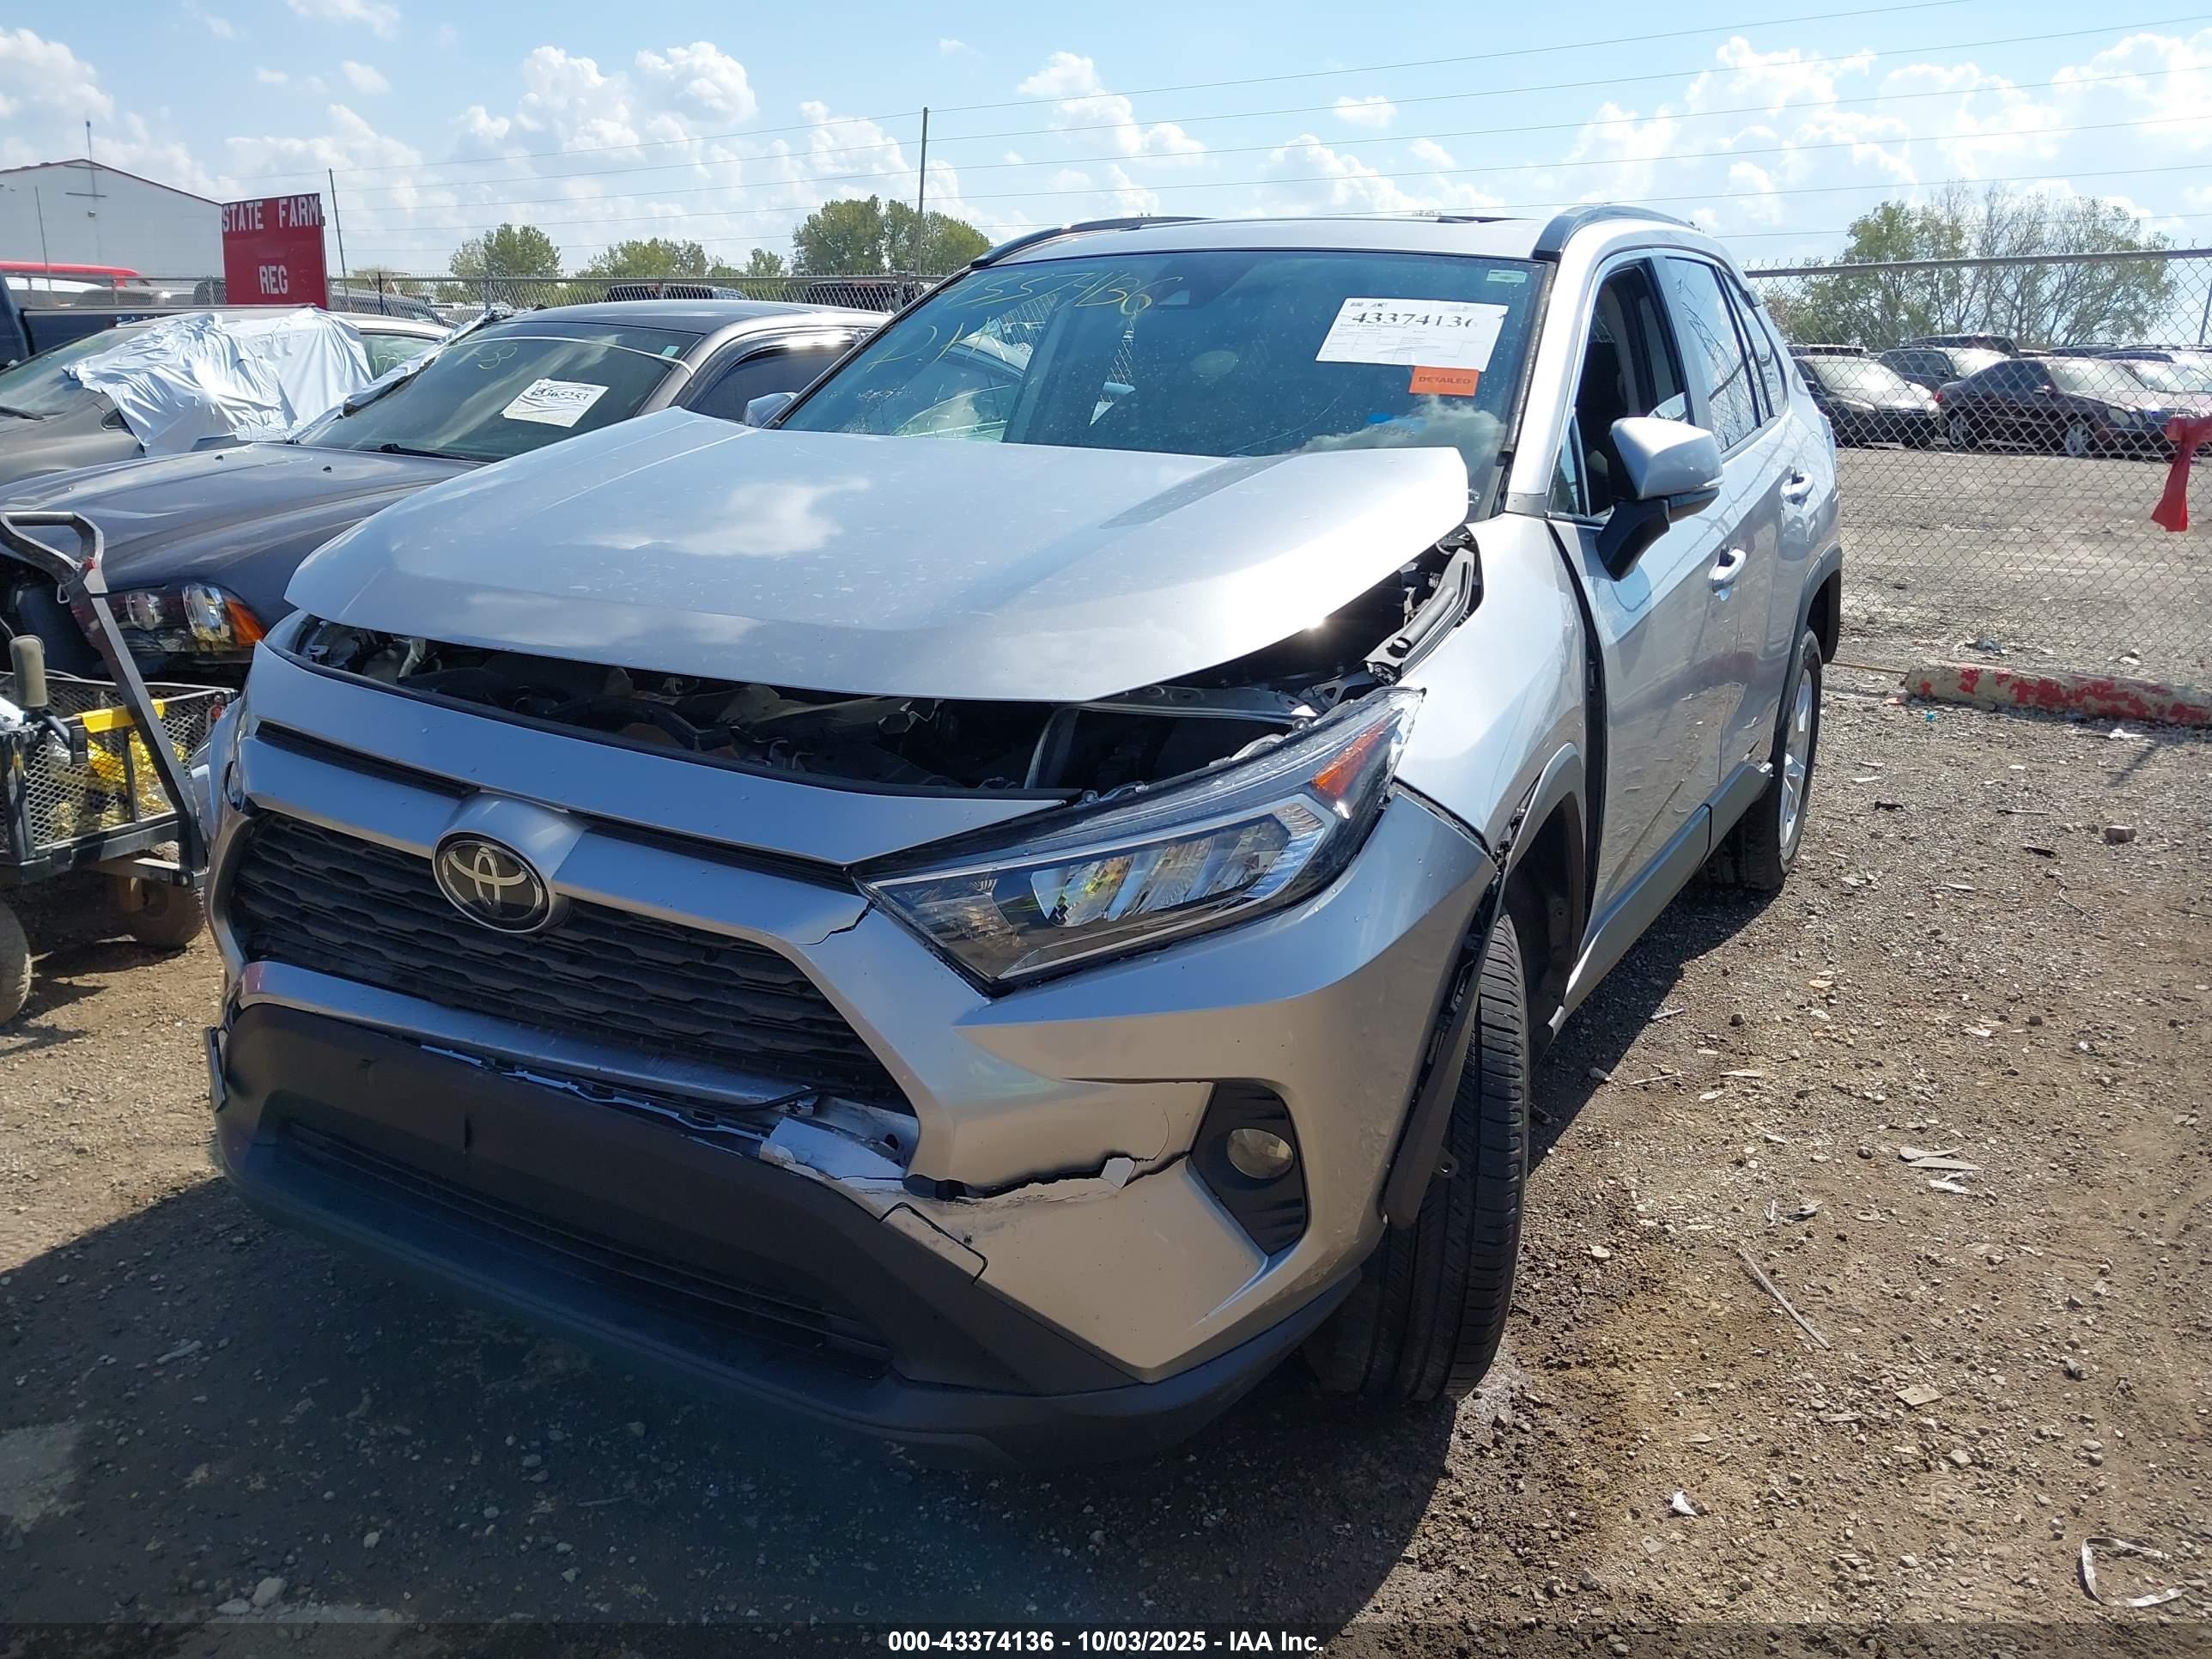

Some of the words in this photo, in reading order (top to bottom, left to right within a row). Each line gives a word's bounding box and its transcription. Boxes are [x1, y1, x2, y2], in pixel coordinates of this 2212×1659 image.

[222, 201, 264, 232] STATE
[278, 196, 319, 228] FARM
[1419, 376, 1471, 385] DETAILED
